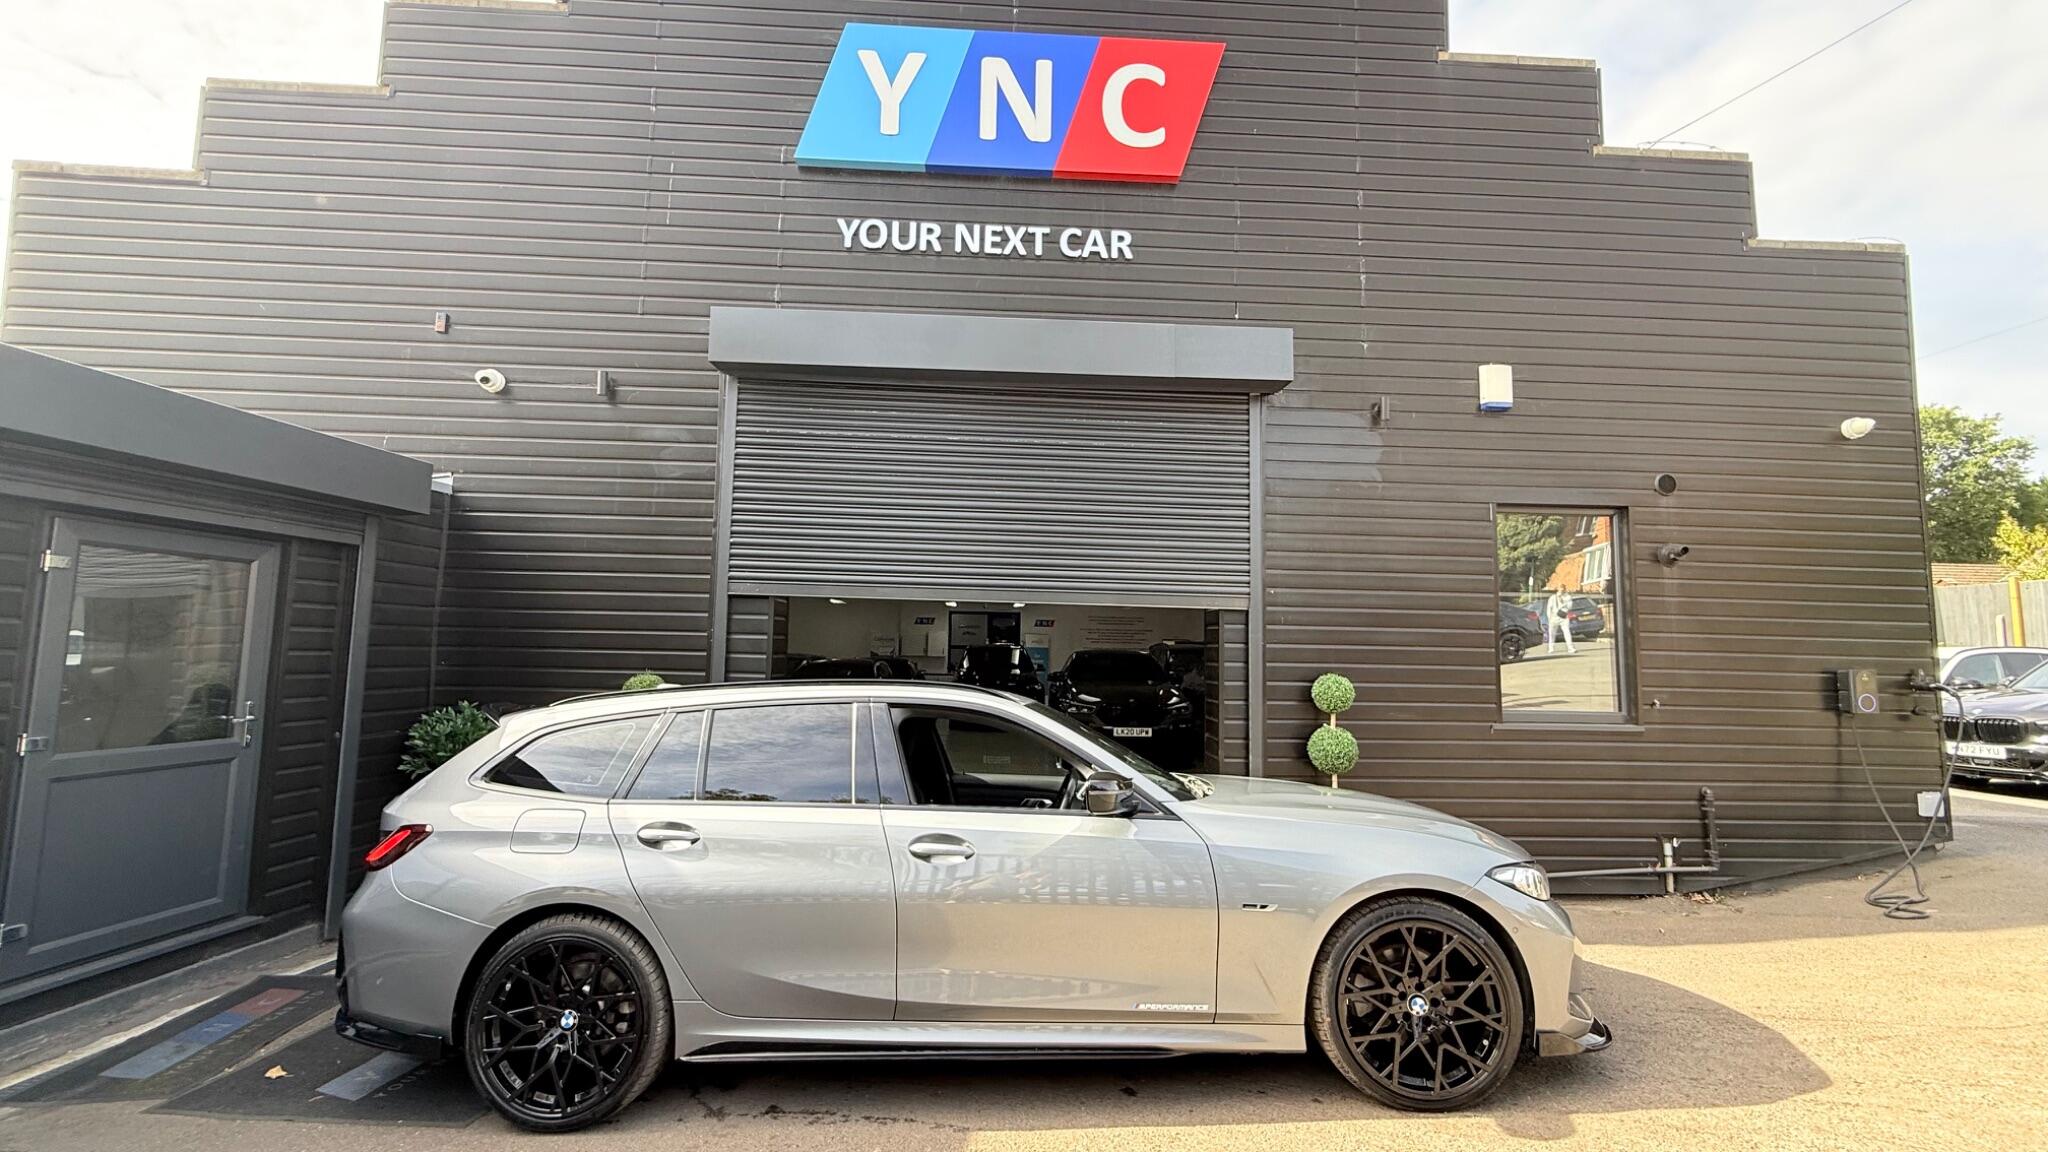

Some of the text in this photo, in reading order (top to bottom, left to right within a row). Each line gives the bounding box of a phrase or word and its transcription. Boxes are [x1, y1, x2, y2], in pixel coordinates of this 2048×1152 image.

[837, 217, 1134, 261] YOUR NEXT CAR
